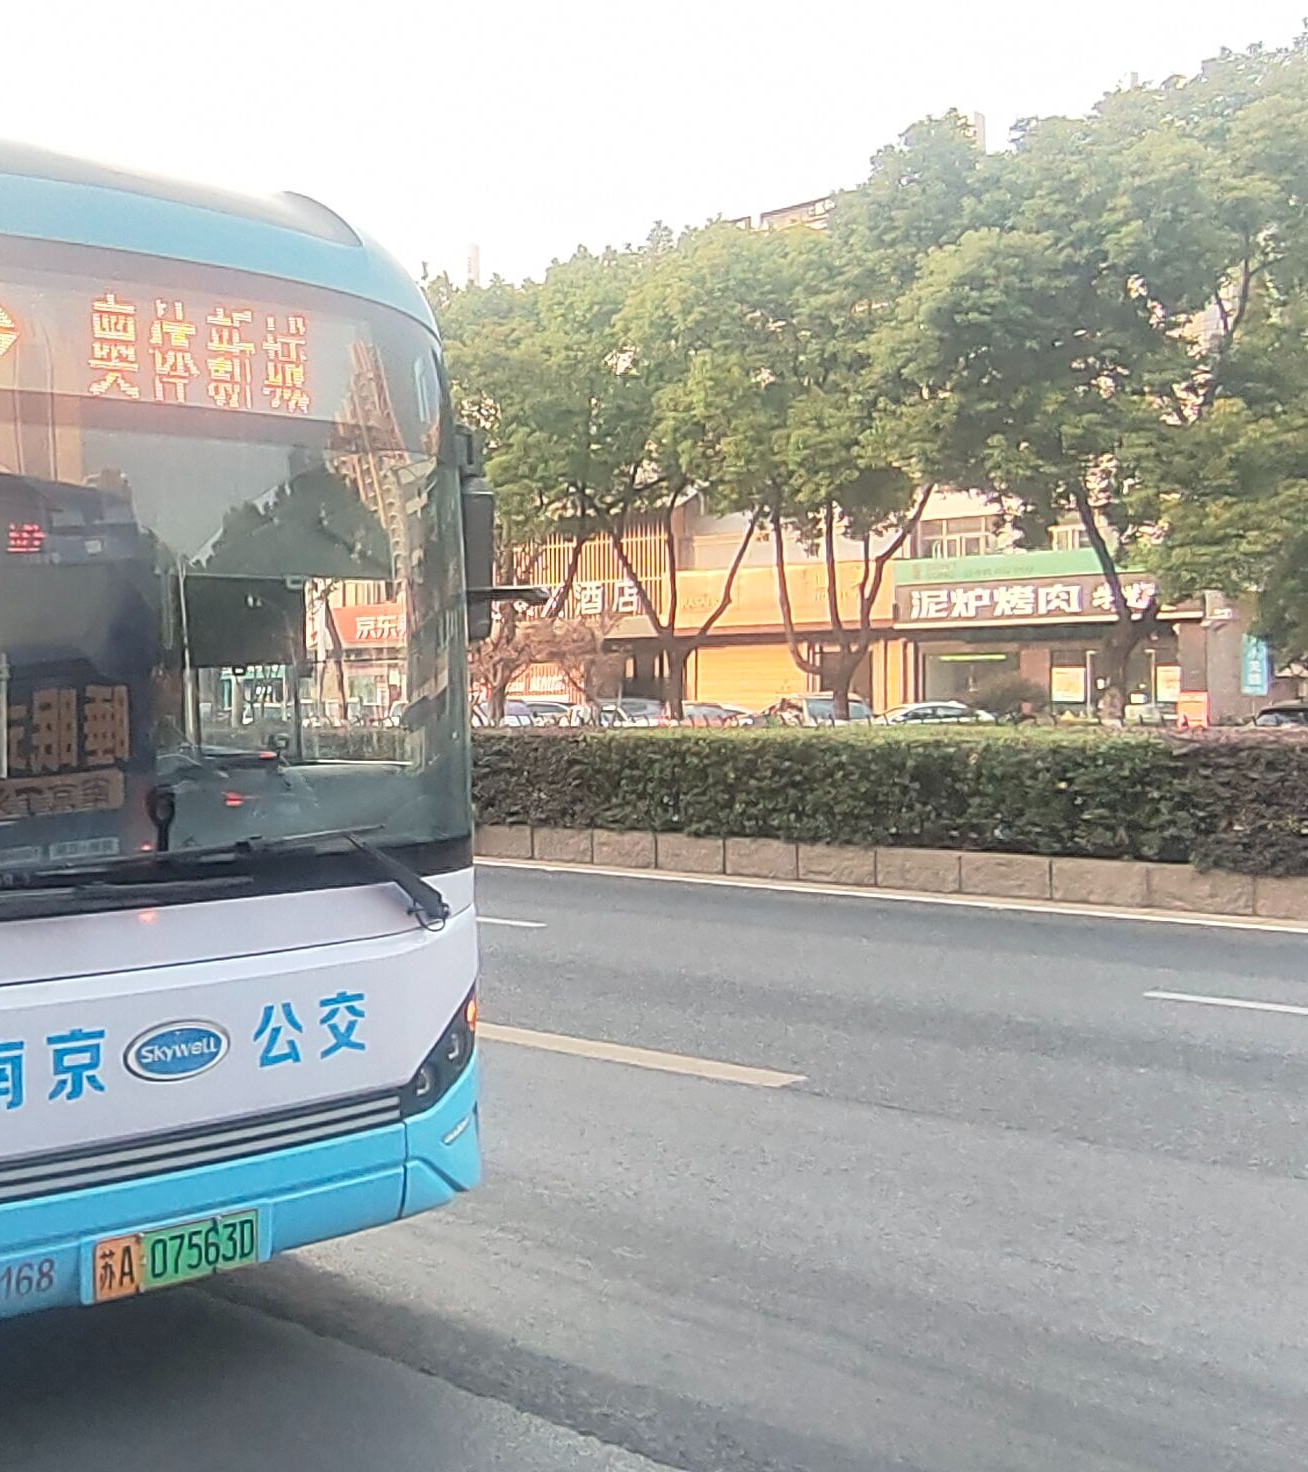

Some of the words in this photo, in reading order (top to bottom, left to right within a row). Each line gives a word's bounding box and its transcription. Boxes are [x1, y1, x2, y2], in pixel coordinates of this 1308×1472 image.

[910, 584, 1082, 619] 泥炉烤肉
[140, 1035, 219, 1064] Skywell
[253, 990, 366, 1068] 公交
[99, 1245, 135, 1291] 苏A
[151, 1218, 255, 1279] 07563D
